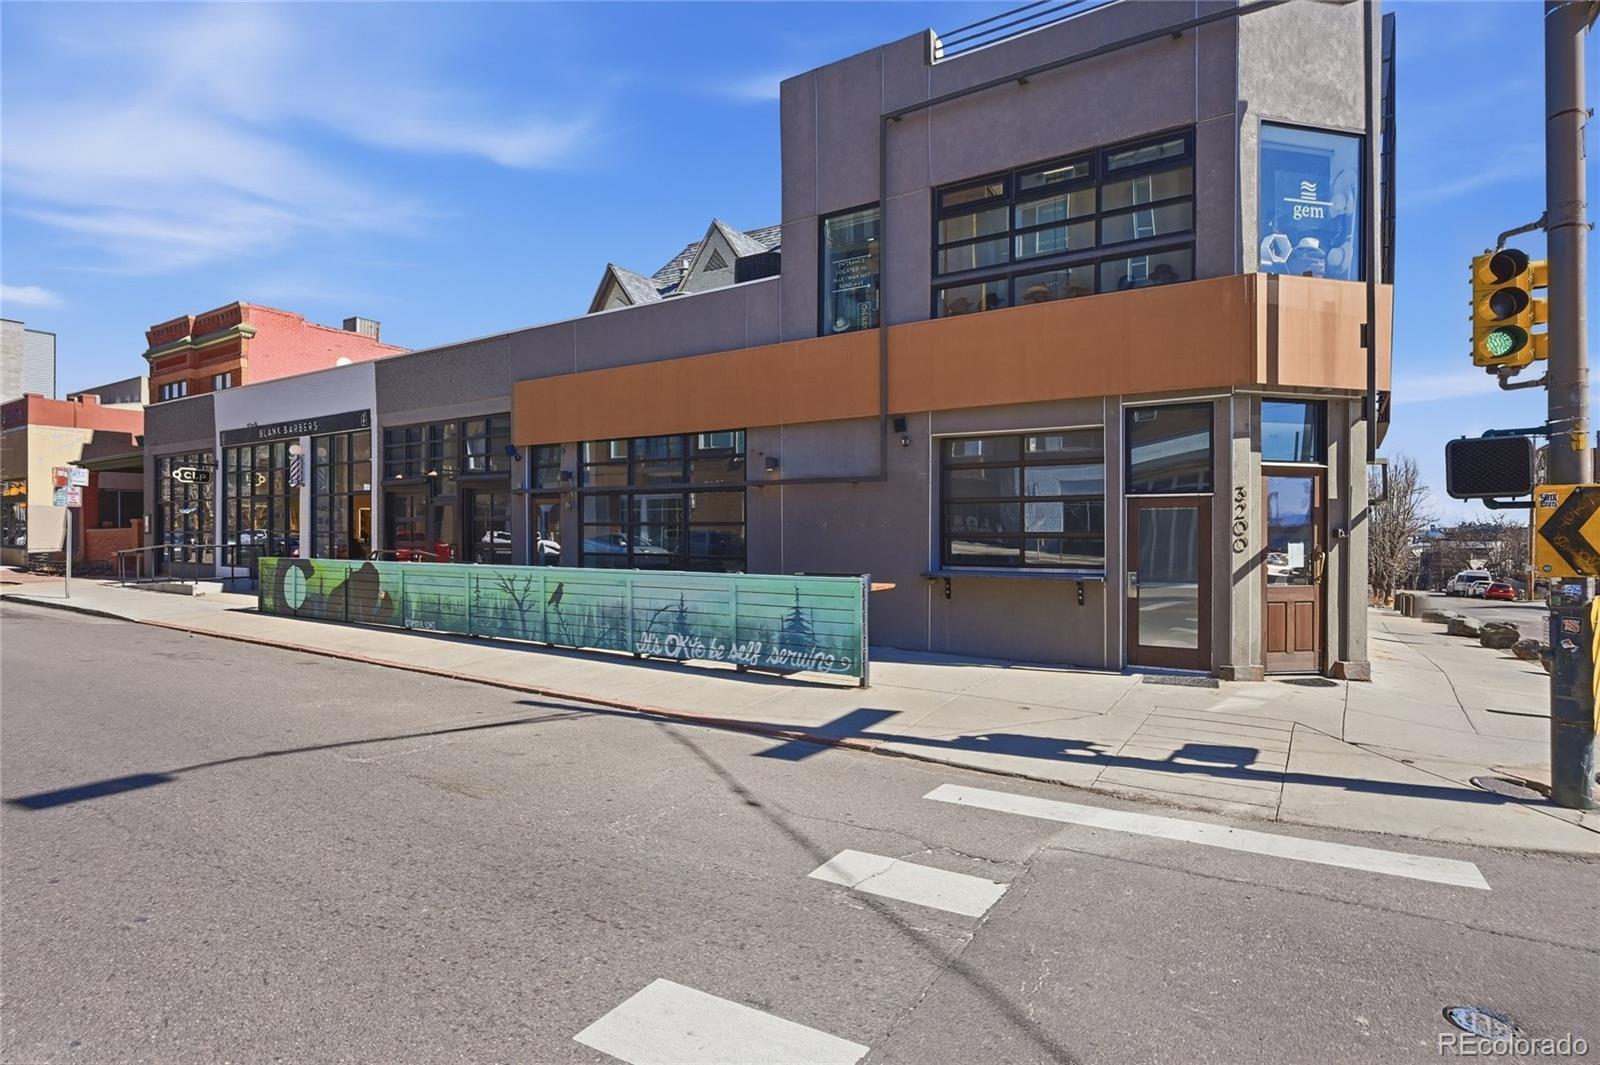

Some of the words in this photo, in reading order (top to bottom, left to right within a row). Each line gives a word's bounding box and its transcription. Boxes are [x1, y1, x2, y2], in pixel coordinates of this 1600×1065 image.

[1293, 205, 1324, 221] gem
[259, 427, 281, 438] BLANK
[284, 421, 318, 434] BARBERS
[1232, 485, 1248, 554] 3200
[665, 633, 690, 659] OK
[708, 638, 725, 660] be
[728, 640, 763, 666] self
[766, 643, 851, 673] serving
